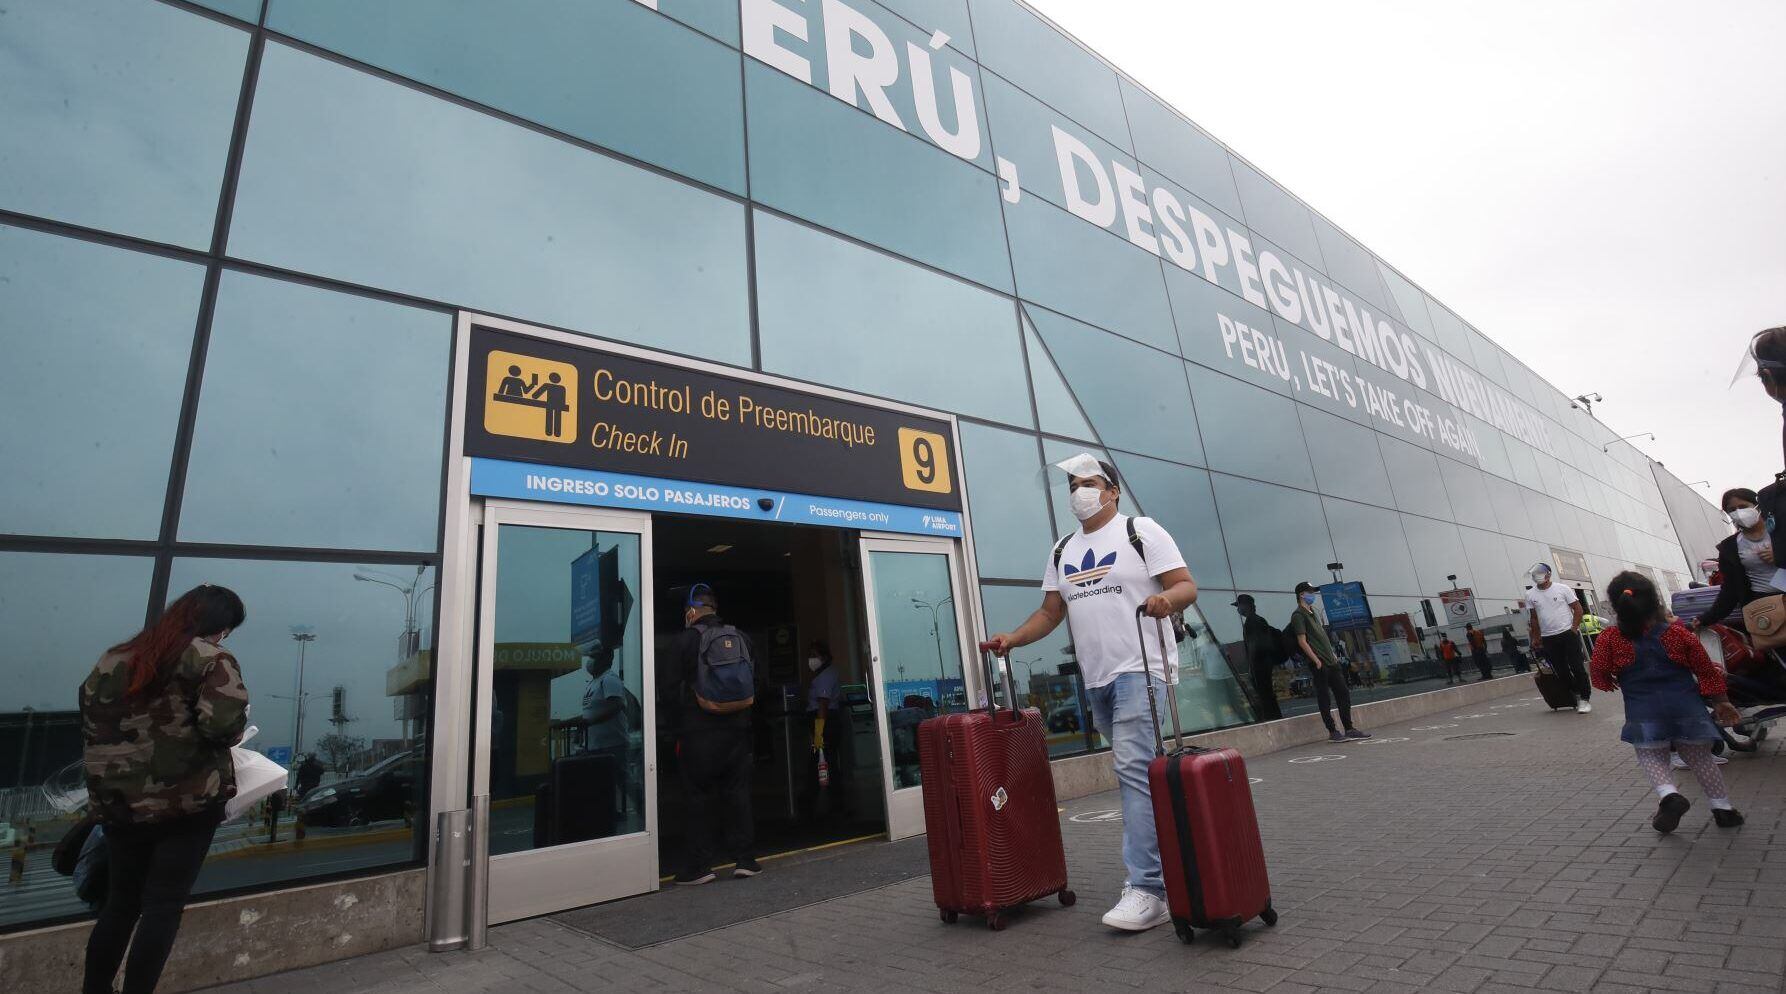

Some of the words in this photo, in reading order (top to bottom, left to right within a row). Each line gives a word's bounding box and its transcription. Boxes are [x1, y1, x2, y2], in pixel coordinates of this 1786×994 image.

[630, 0, 1021, 204] ERÚ,
[1051, 124, 1427, 390] DESPEGUEMOS
[1217, 311, 1300, 391] PERU,
[1300, 350, 1357, 408] LET'S
[1355, 376, 1404, 428] TAKE
[1403, 399, 1435, 440] OFF
[593, 368, 691, 415] Control
[701, 390, 730, 421] de
[738, 395, 875, 448] Preembarque
[591, 422, 663, 456] Check
[668, 433, 688, 459] In
[912, 437, 936, 485] 9
[526, 474, 609, 497] INGRESO
[614, 484, 660, 502] SOLO
[664, 489, 751, 511] PASAJEROS
[809, 504, 867, 521] Passengers
[868, 512, 889, 526] only
[931, 516, 947, 524] LIMA
[932, 522, 957, 532] AIRPORT
[1067, 585, 1123, 602] skateboarding
